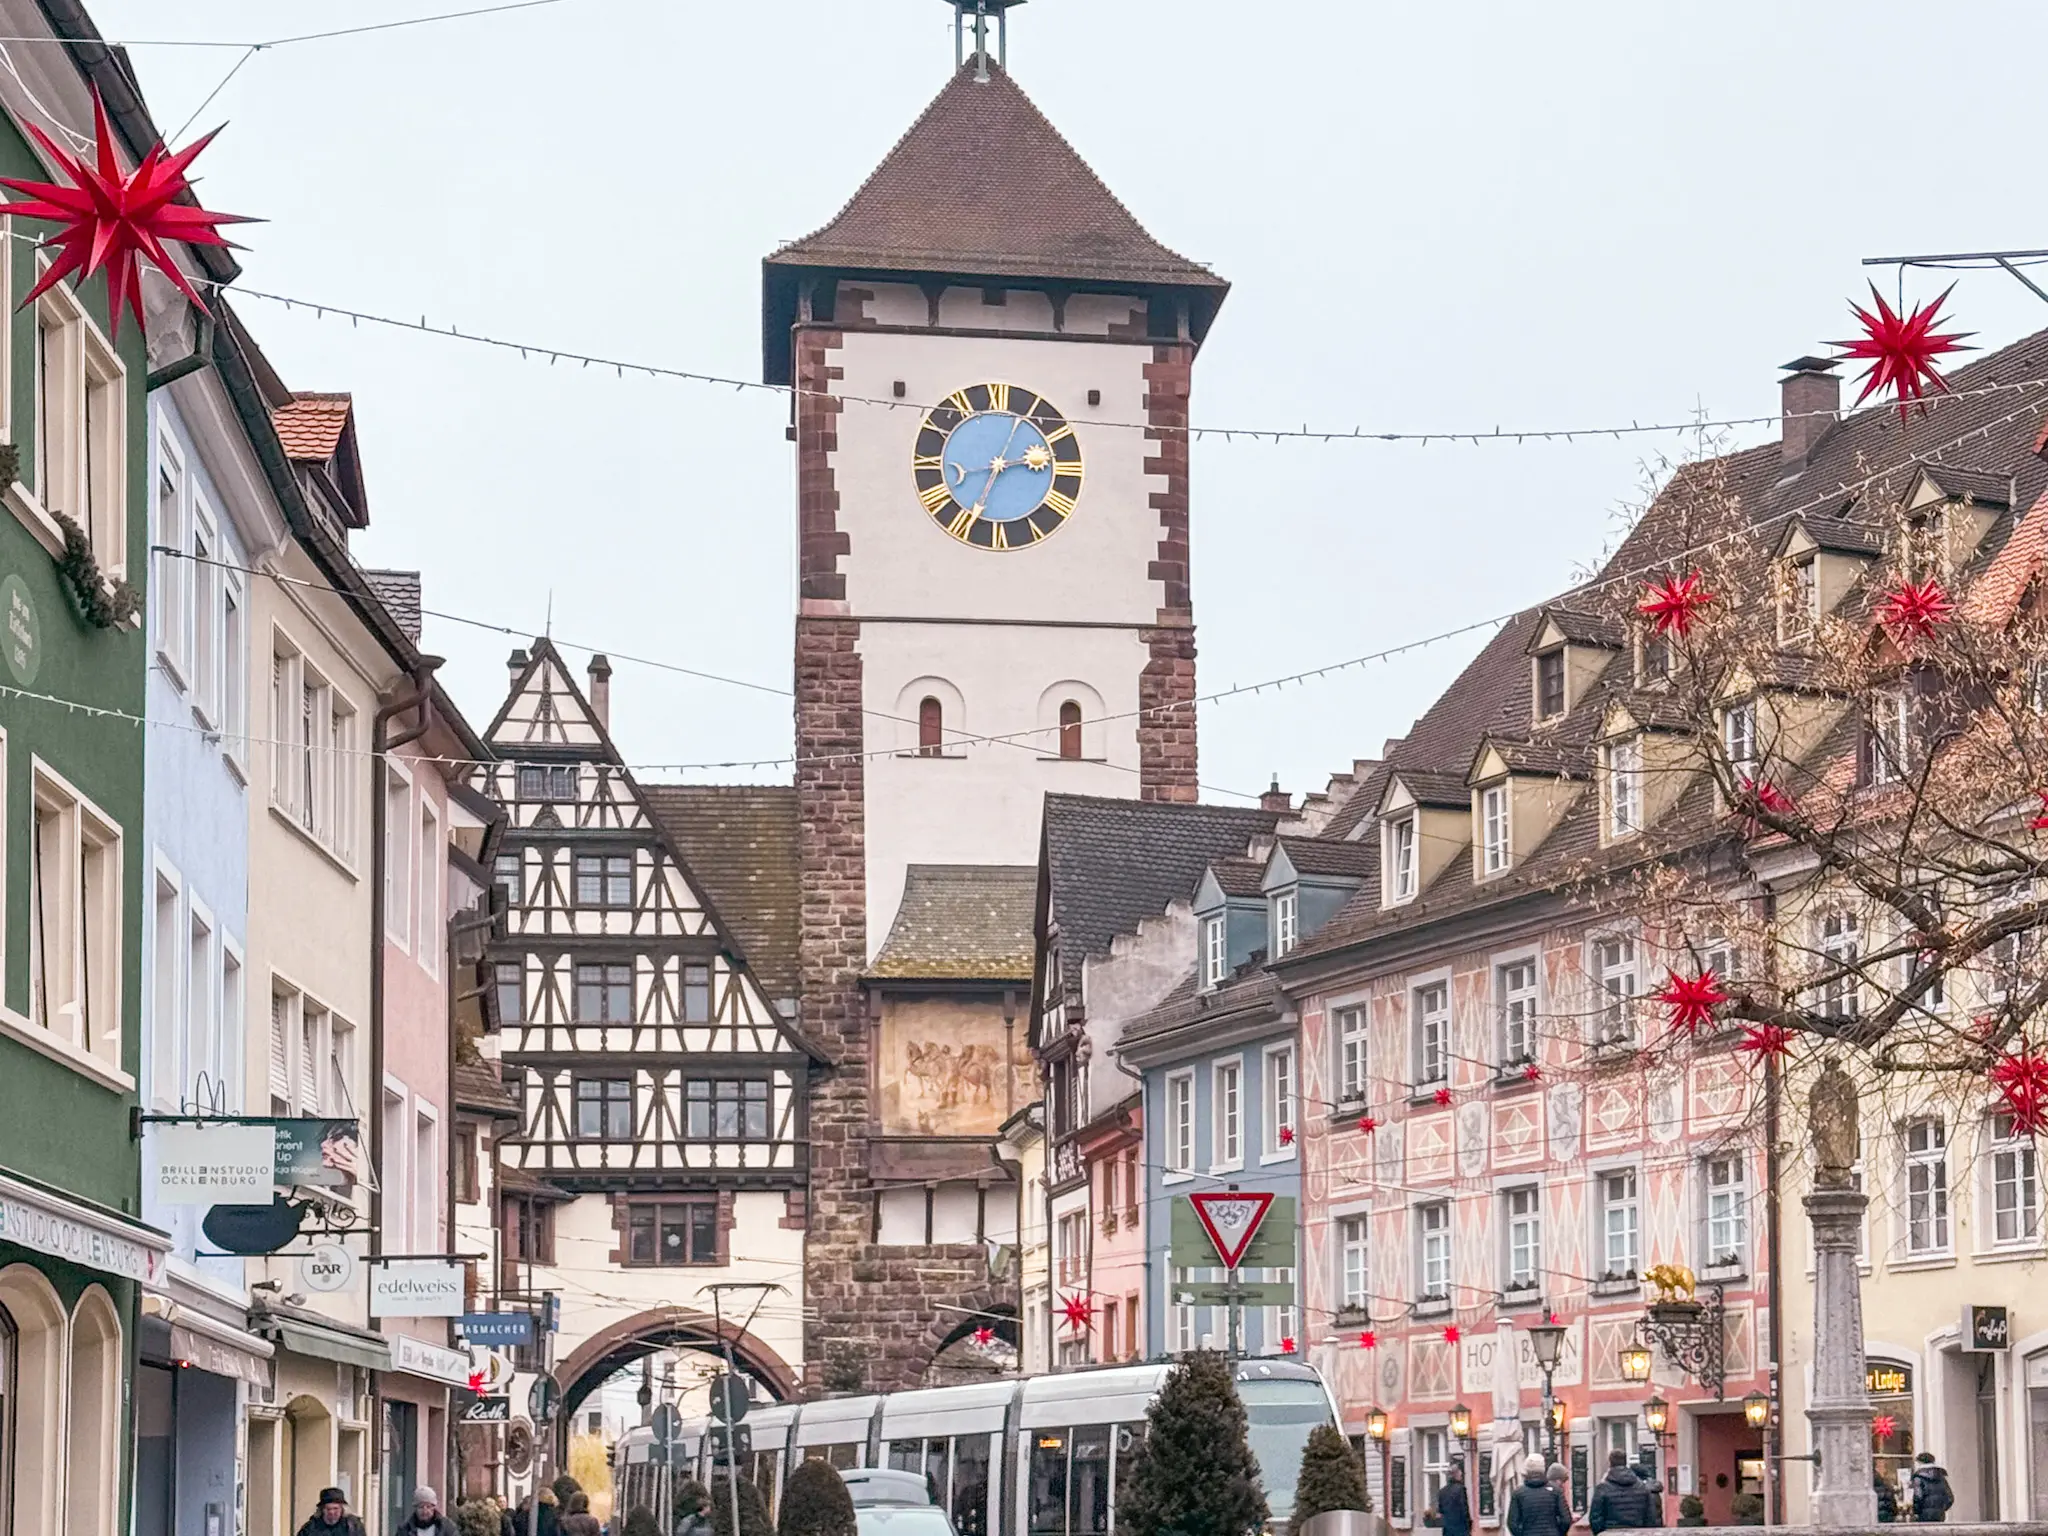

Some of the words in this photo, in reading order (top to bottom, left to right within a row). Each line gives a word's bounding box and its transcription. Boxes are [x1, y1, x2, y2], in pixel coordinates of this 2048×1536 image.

[987, 384, 1009, 410] XII
[1026, 397, 1042, 417] I
[922, 418, 949, 439] X
[1047, 425, 1073, 443] II
[914, 454, 941, 470] IX
[1055, 461, 1082, 477] III
[992, 521, 1008, 548] VI
[1027, 518, 1045, 541] V
[277, 1151, 292, 1162] Up
[161, 1166, 269, 1175] BRILLENSTUDIO
[161, 1176, 257, 1185] OCKLENBURG
[311, 1263, 342, 1275] BAR
[378, 1279, 457, 1294] edelweiss
[1874, 1369, 1906, 1393] Lodge
